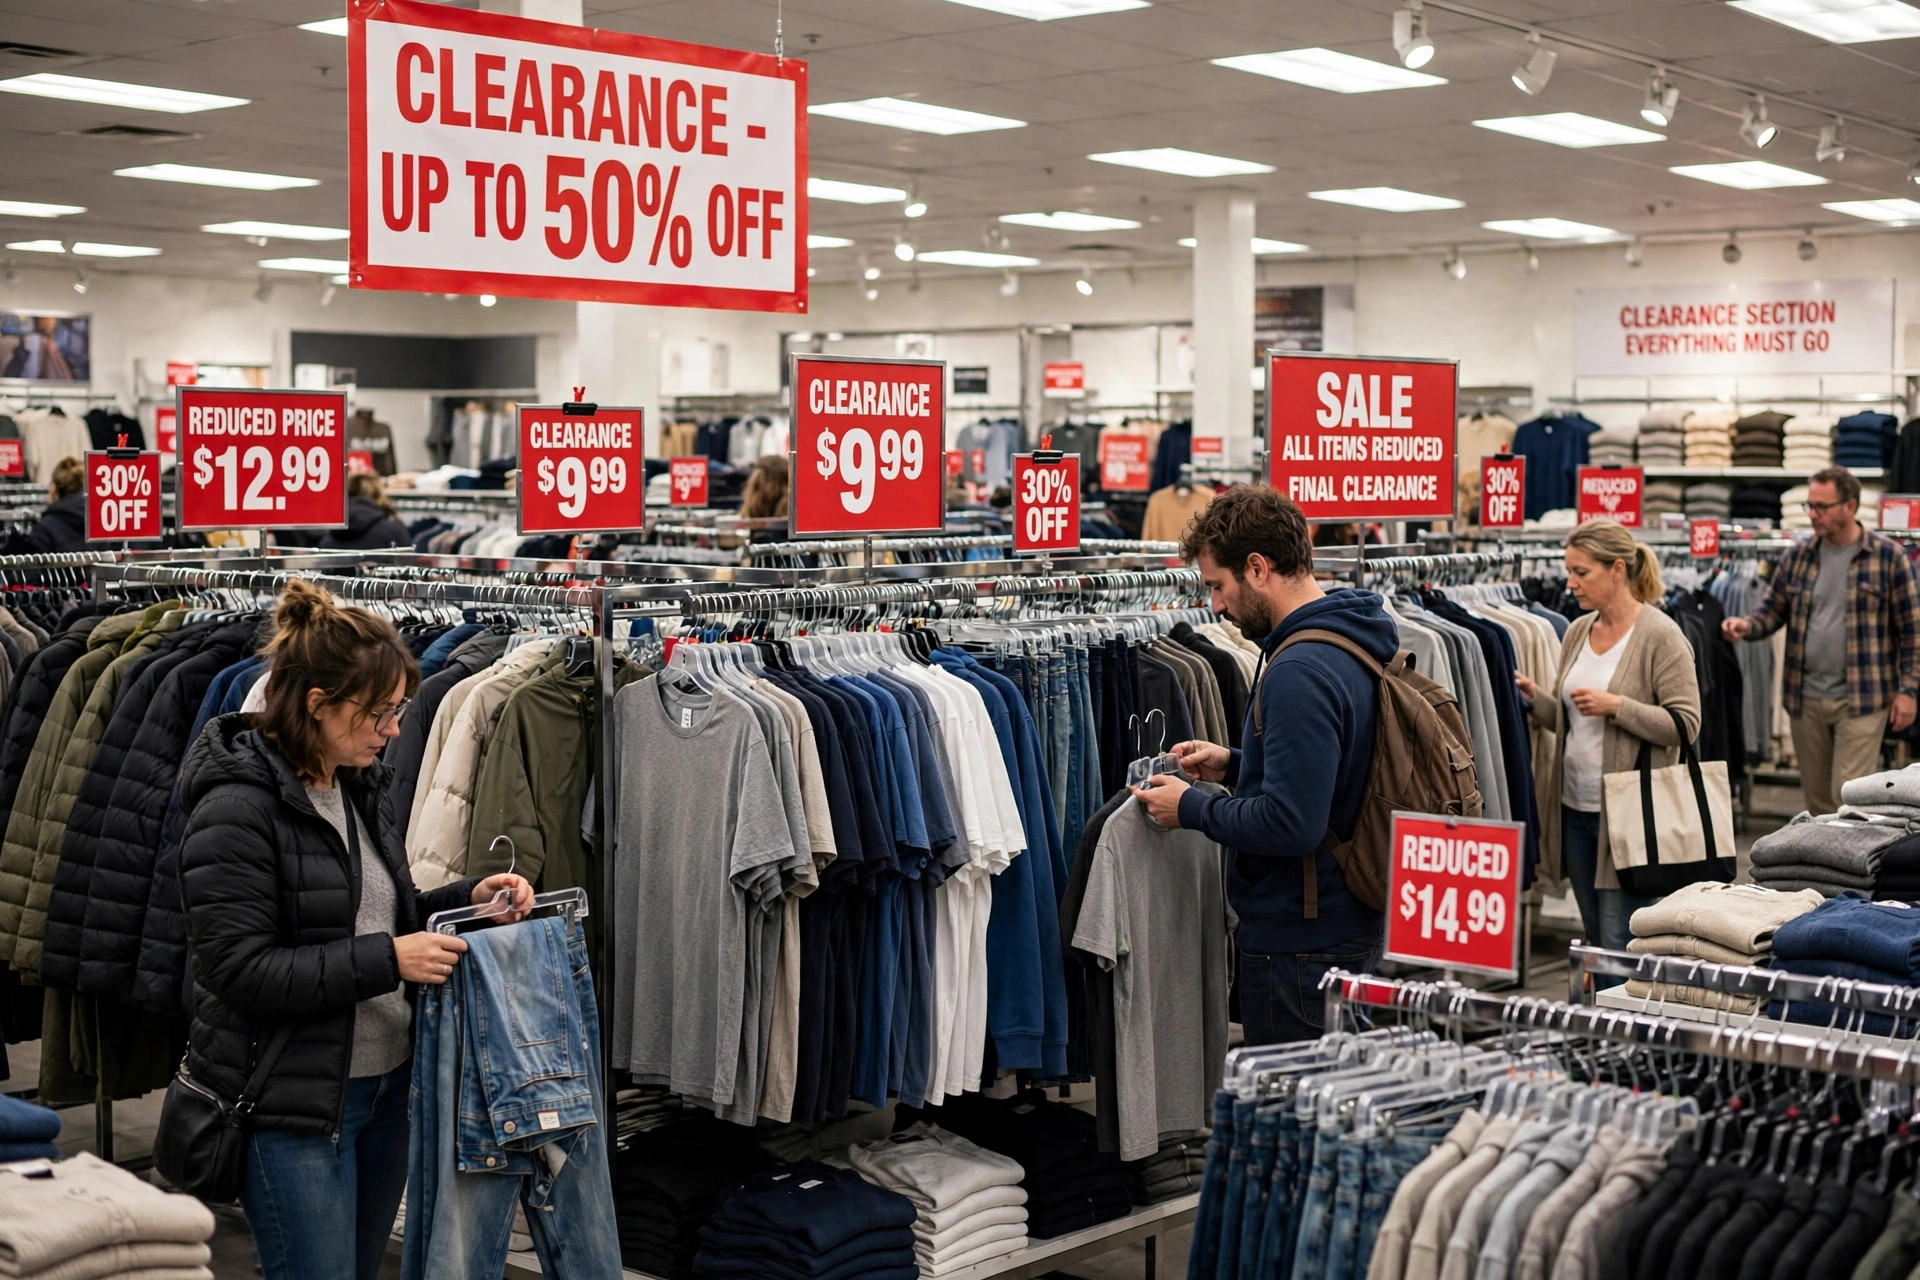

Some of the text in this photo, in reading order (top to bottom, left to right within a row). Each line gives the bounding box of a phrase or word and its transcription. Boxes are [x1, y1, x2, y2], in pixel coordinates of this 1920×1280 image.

[395, 41, 767, 157] CLEARANCE -
[381, 151, 785, 269] UP TO 50% OFF
[1619, 300, 1837, 329] CLEARANCE SECTION
[1625, 329, 1831, 356] EVERYTHING MUST GO
[809, 379, 931, 418] CLEARANCE
[1315, 371, 1413, 430] SALE
[188, 406, 277, 436] REDUCED
[282, 408, 336, 438] PRICE
[529, 421, 633, 449] CLEARANCE
[1282, 434, 1444, 462] ALL ITEMS REDUCED
[95, 464, 152, 497] 30%
[193, 443, 331, 511] $12.99
[1021, 468, 1072, 504] 30%
[1288, 474, 1438, 502] FINAL CLEARANCE
[1486, 466, 1520, 494] 30%
[1582, 477, 1637, 495] REDUCED
[100, 498, 148, 532] OFF
[1025, 506, 1069, 543] OFF
[1488, 494, 1517, 523] OFF
[1402, 834, 1510, 880] REDUCED
[1399, 881, 1507, 944] $14.99
